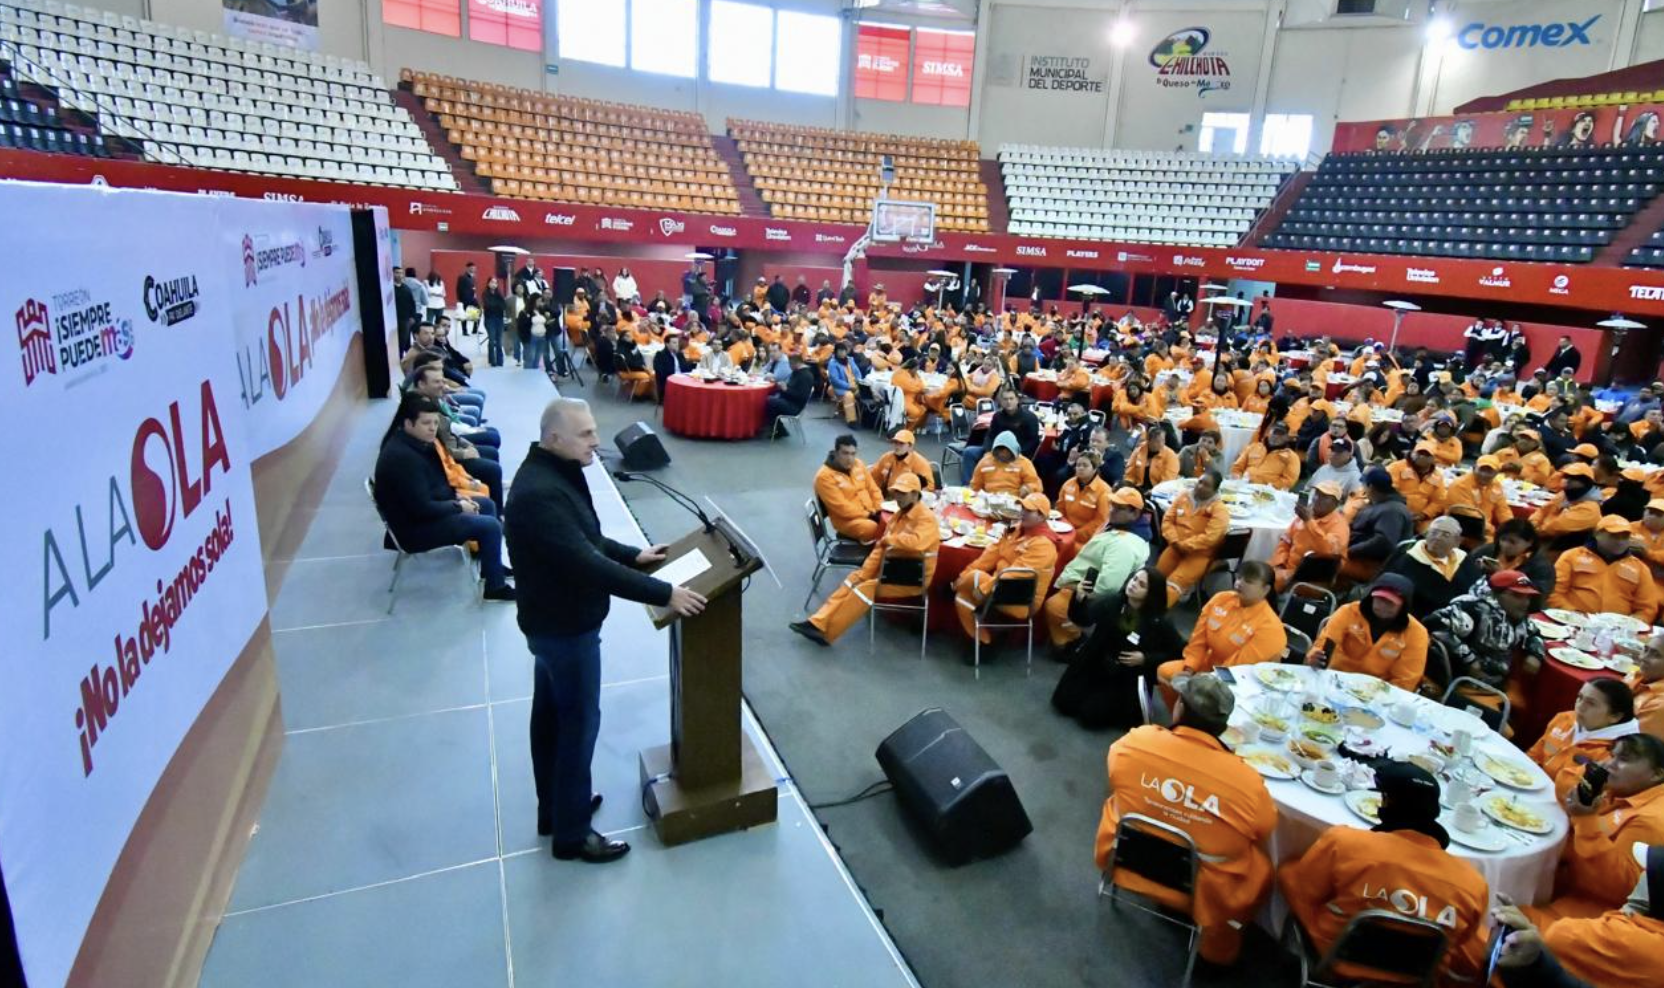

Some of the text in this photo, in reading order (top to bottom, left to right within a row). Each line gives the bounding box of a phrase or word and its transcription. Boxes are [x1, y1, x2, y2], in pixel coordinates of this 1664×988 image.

[1031, 56, 1090, 68] INSTITUTO
[1159, 56, 1230, 76] CHILCHOTA
[922, 61, 963, 77] SIMSA
[1030, 67, 1088, 80] MUNICIPAL
[1029, 78, 1103, 92] DEL DEPORTE
[1162, 79, 1190, 88] Queso
[263, 192, 304, 203] SIMSA
[545, 213, 576, 225] telcel
[1016, 246, 1047, 257] SIMSA
[1066, 250, 1099, 258] PLAYERS
[144, 275, 199, 322] COAHUILA
[75, 497, 234, 778] ¡No la dejamos sola!
[1363, 883, 1388, 901] LA
